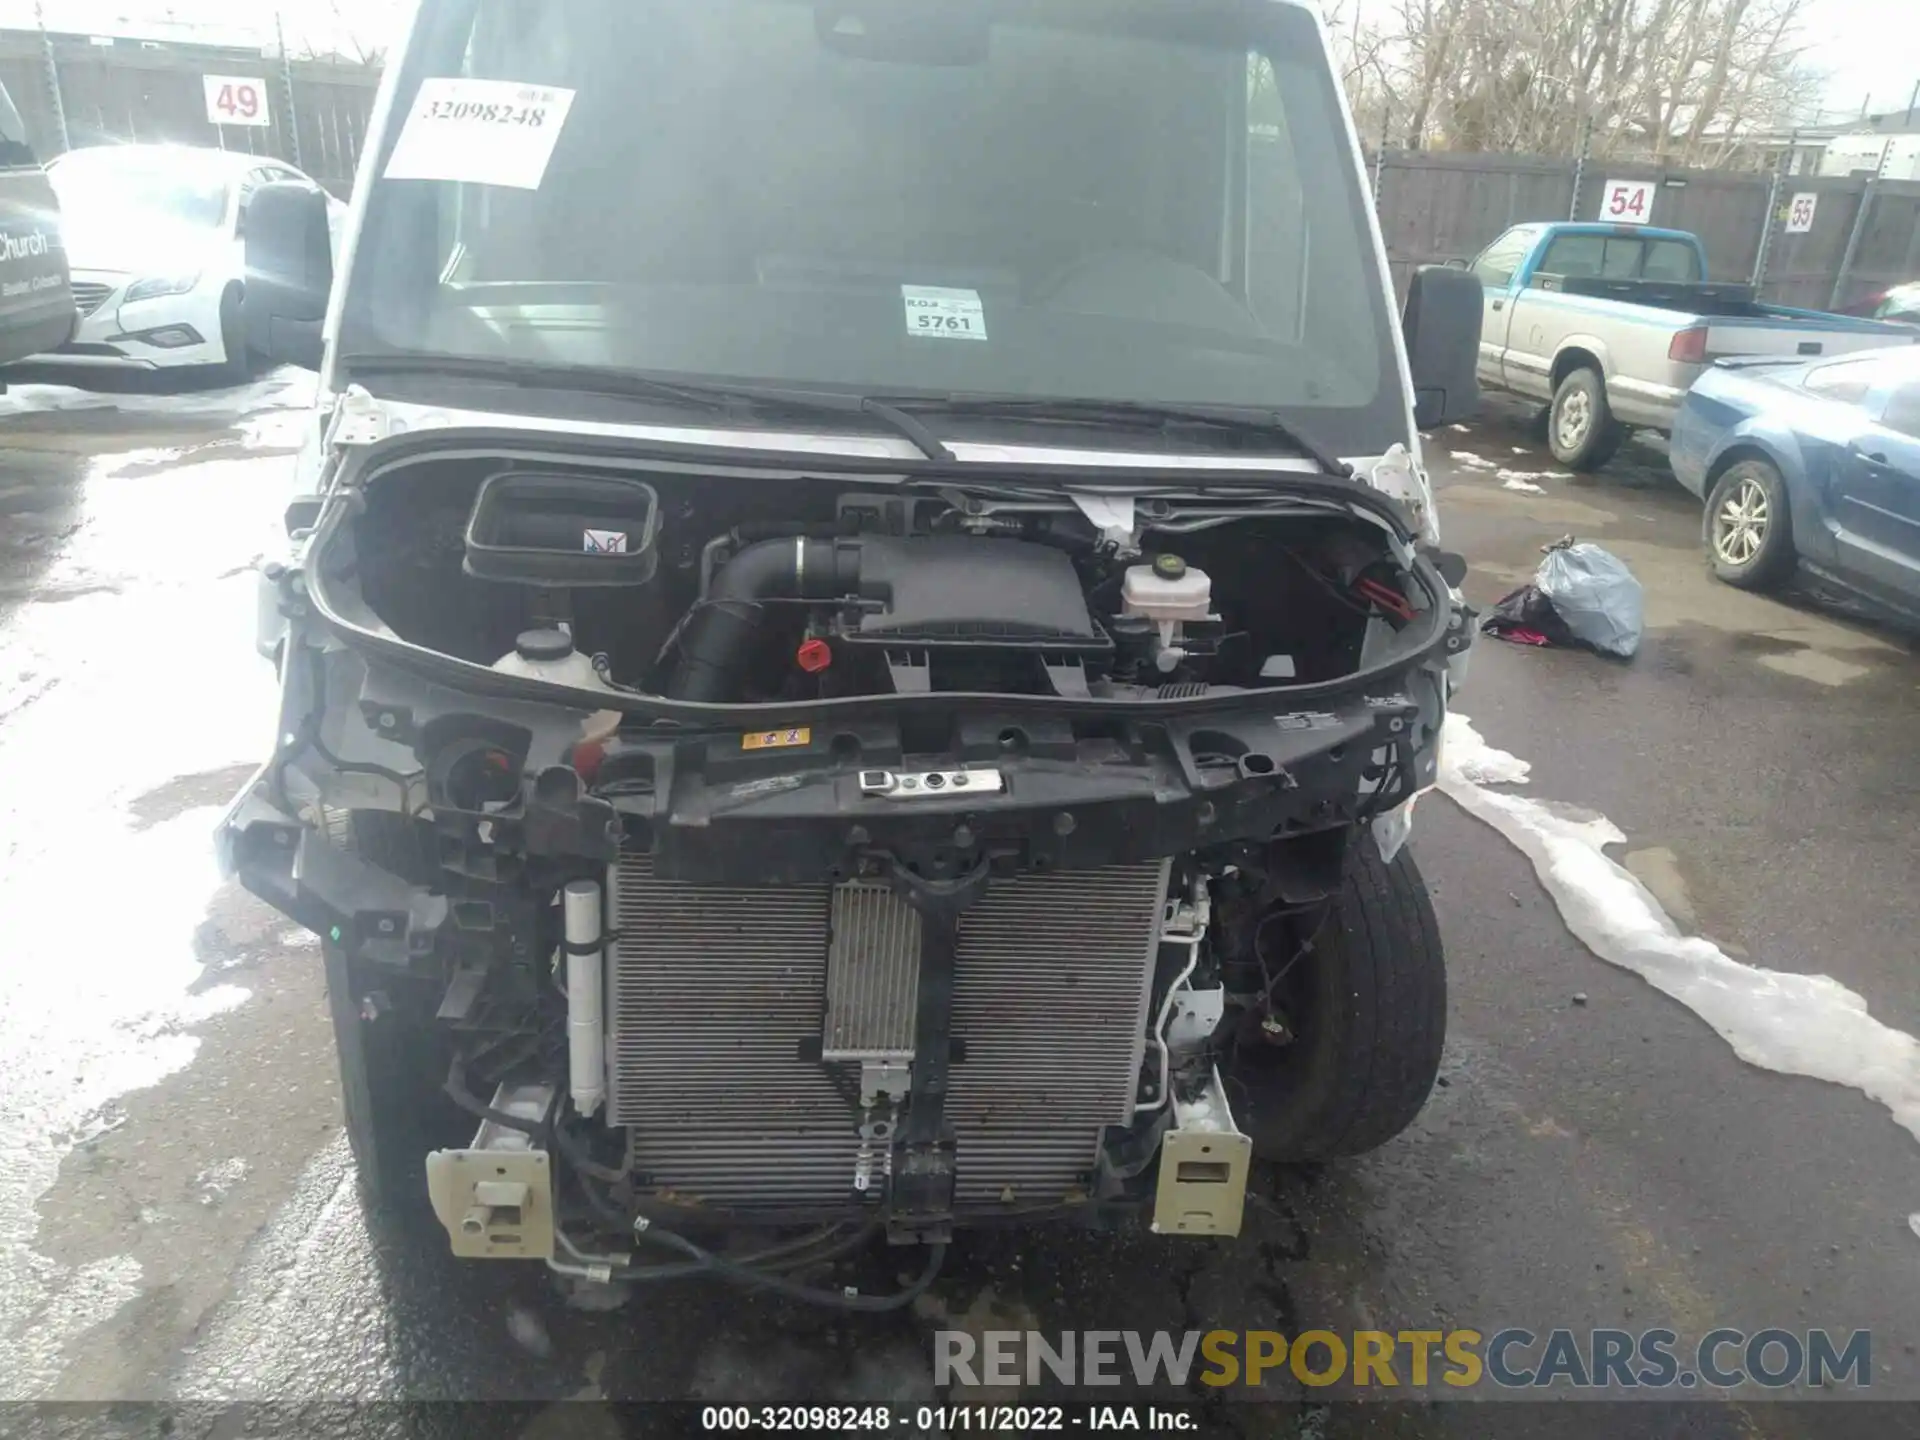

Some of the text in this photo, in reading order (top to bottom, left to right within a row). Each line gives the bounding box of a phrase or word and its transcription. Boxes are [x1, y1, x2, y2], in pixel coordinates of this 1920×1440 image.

[217, 85, 258, 117] 49
[423, 101, 546, 127] 32098248
[1610, 187, 1645, 216] 54
[1792, 199, 1814, 226] 55
[918, 315, 970, 330] 5761
